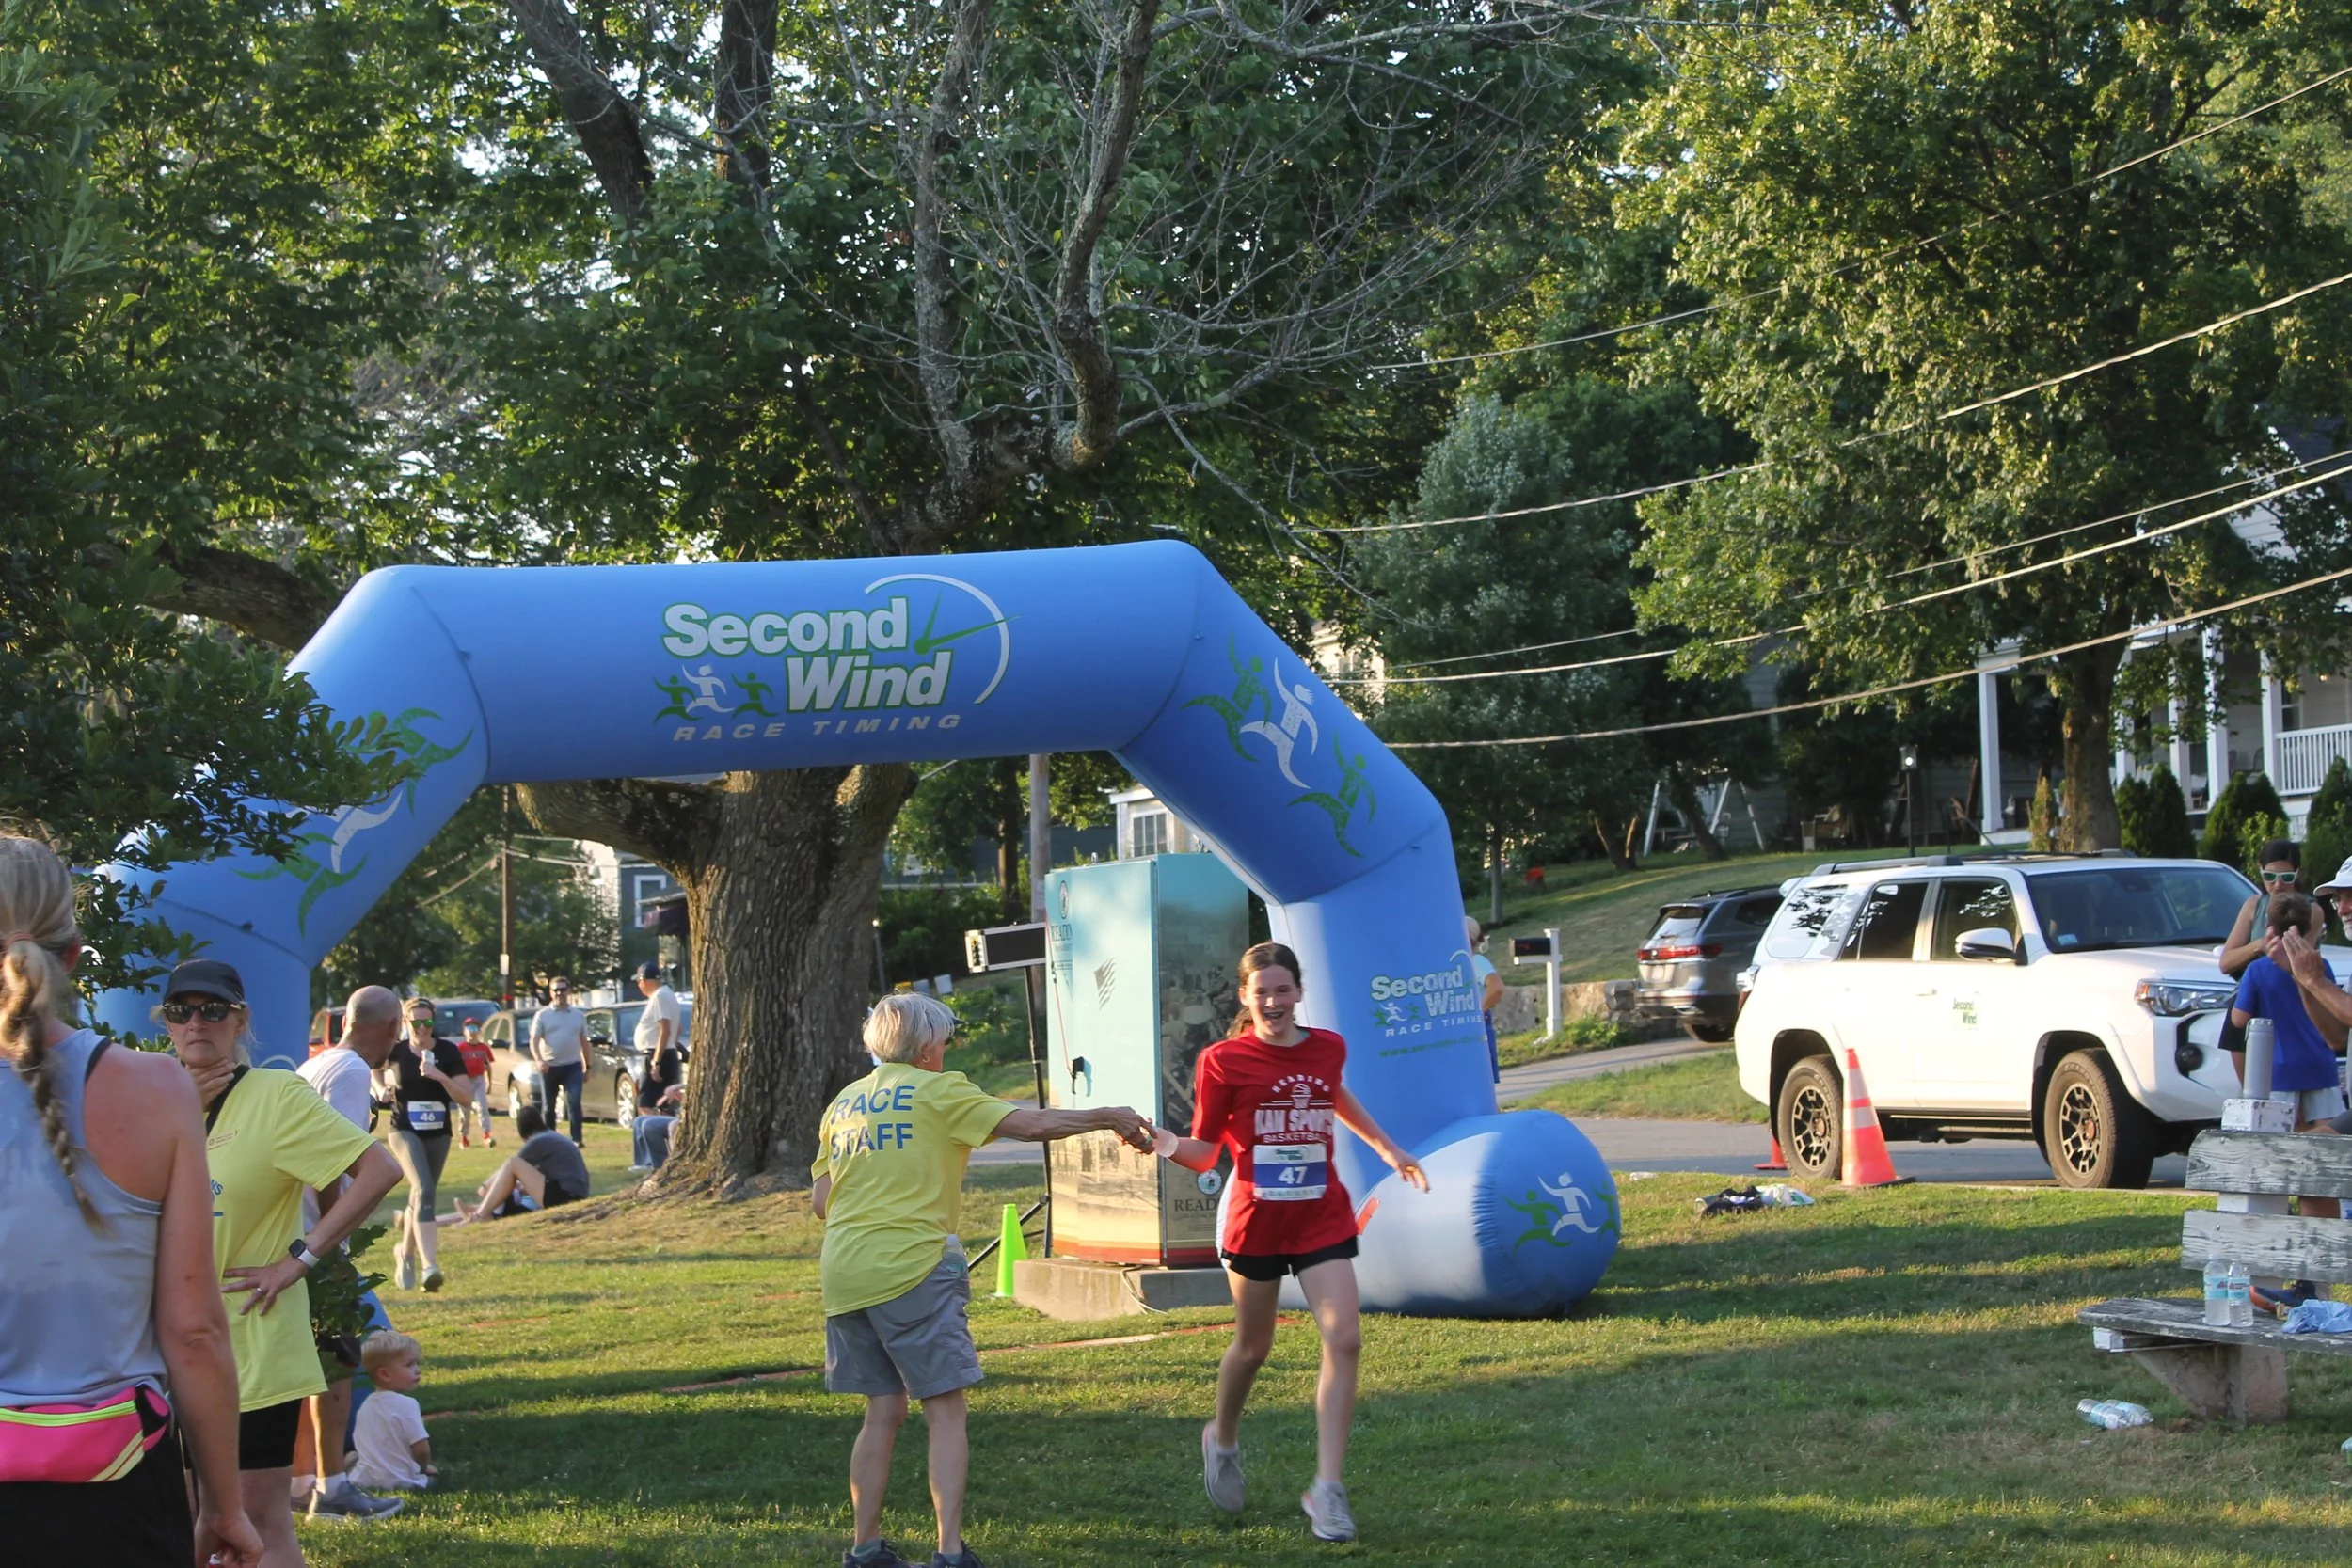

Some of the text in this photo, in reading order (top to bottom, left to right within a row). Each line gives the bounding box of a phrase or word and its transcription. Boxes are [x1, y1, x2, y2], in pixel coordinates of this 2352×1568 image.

[661, 595, 908, 657] Second
[785, 649, 953, 712] Wind
[672, 714, 961, 742] RACE TIMING
[1370, 964, 1464, 1002] Second
[1424, 989, 1476, 1018] Wind
[1385, 1022, 1433, 1037] RACE
[420, 1112, 436, 1122] 46
[830, 1085, 916, 1125] RACE
[831, 1123, 914, 1160] STAFF
[1278, 1166, 1308, 1184] 47
[1173, 1198, 1220, 1212] READ
